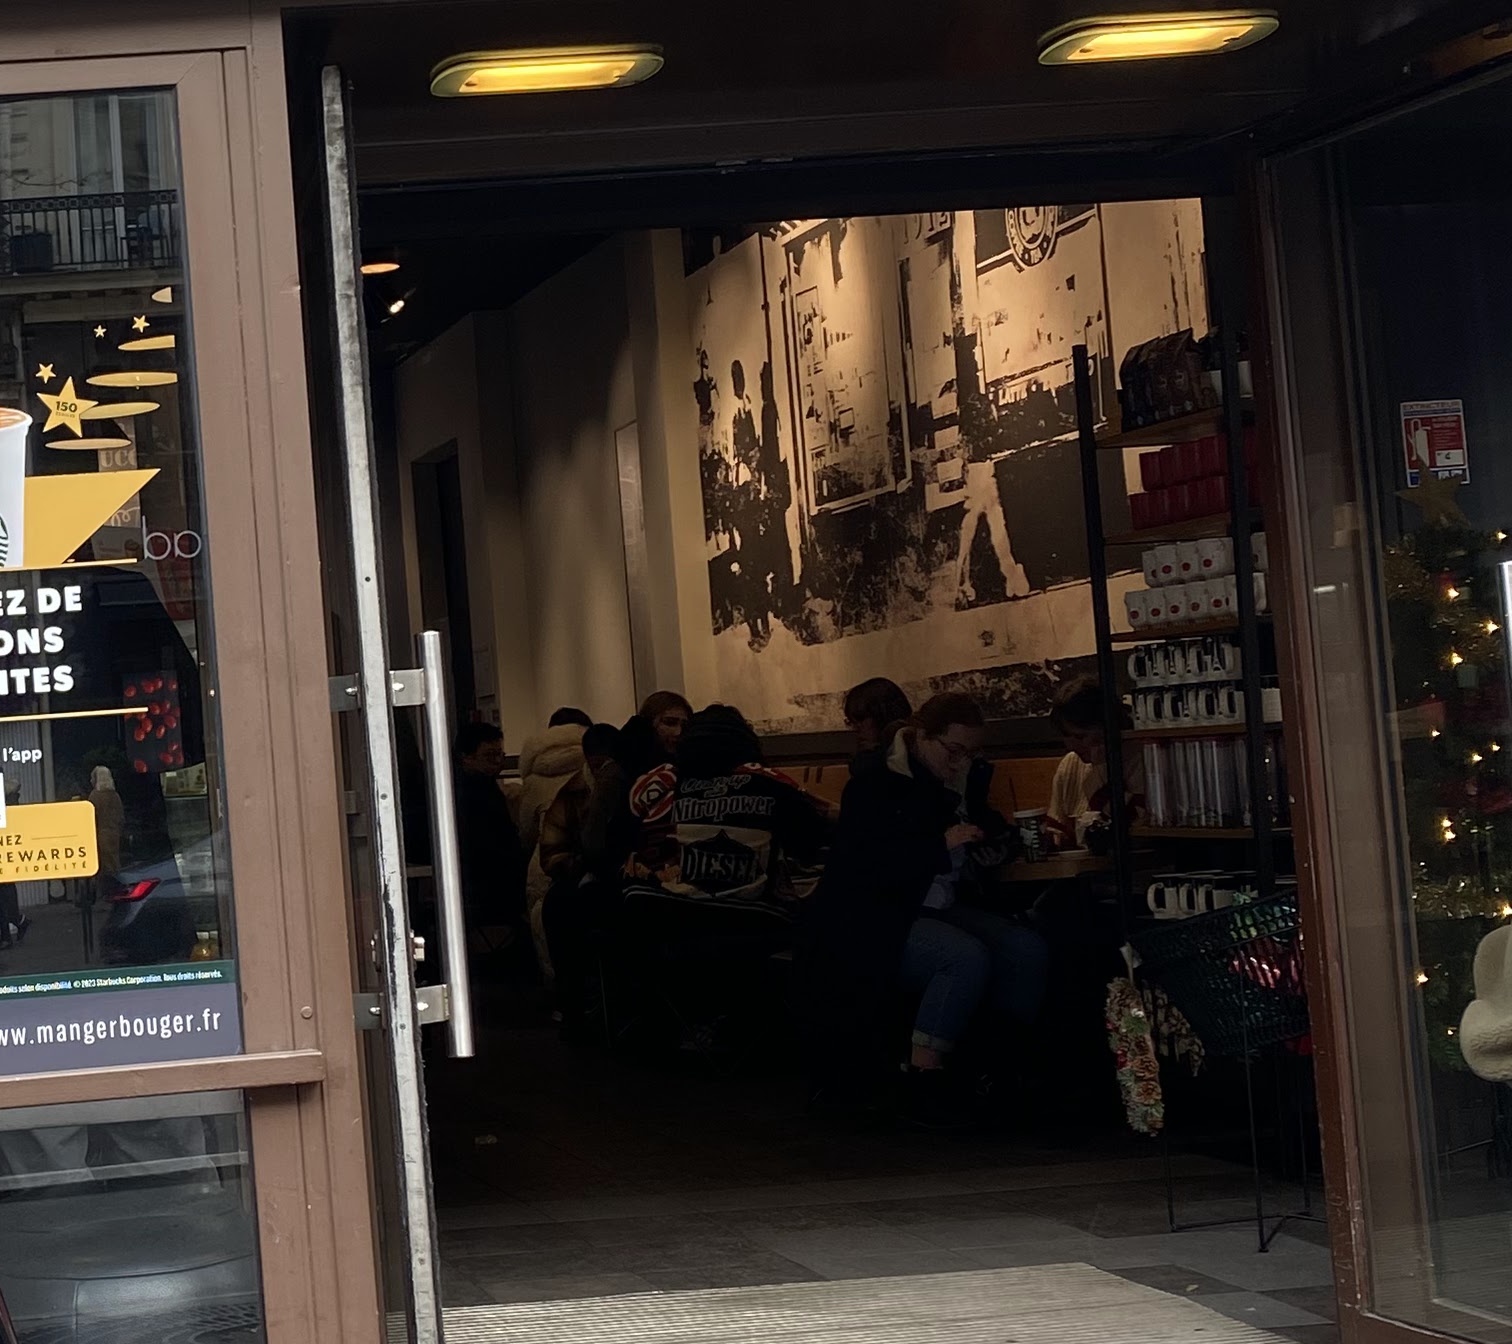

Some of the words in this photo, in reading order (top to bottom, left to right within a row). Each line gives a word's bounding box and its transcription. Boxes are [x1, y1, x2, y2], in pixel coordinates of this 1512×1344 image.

[56, 401, 78, 412] 150
[39, 585, 83, 612] DE
[671, 796, 776, 823] Nitropower
[16, 860, 88, 874] FIDÉLITÉ
[18, 984, 34, 993] selon
[97, 976, 126, 987] Starbucks
[163, 972, 176, 981] Tous
[177, 971, 195, 981] droits
